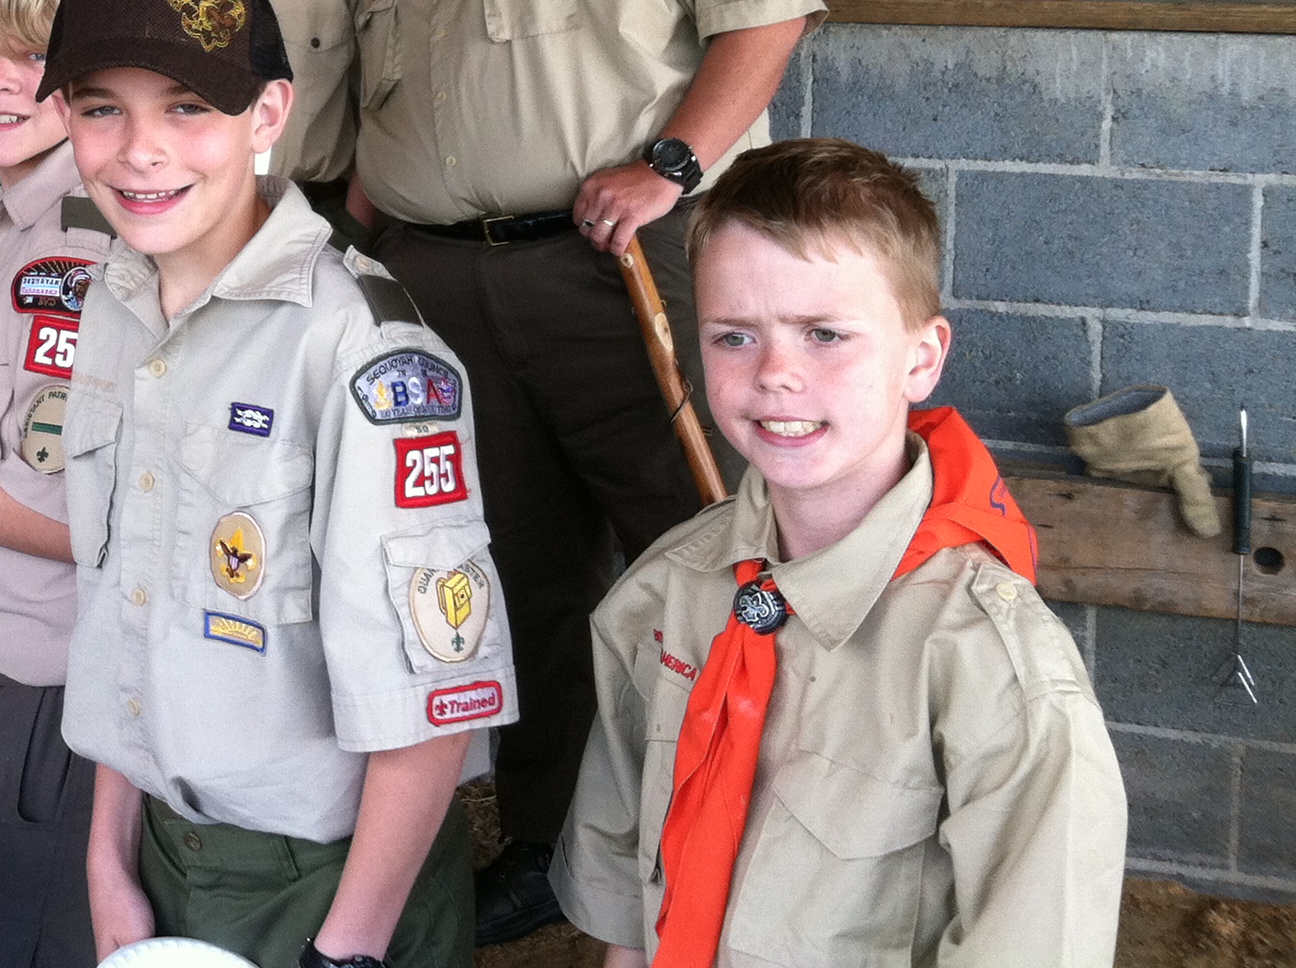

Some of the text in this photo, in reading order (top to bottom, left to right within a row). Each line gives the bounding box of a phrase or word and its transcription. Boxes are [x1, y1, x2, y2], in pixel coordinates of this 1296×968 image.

[34, 326, 79, 368] 25
[366, 357, 413, 386] SEQUOYAH
[48, 391, 68, 402] PATR
[405, 444, 456, 498] 255
[448, 693, 496, 714] Trained
